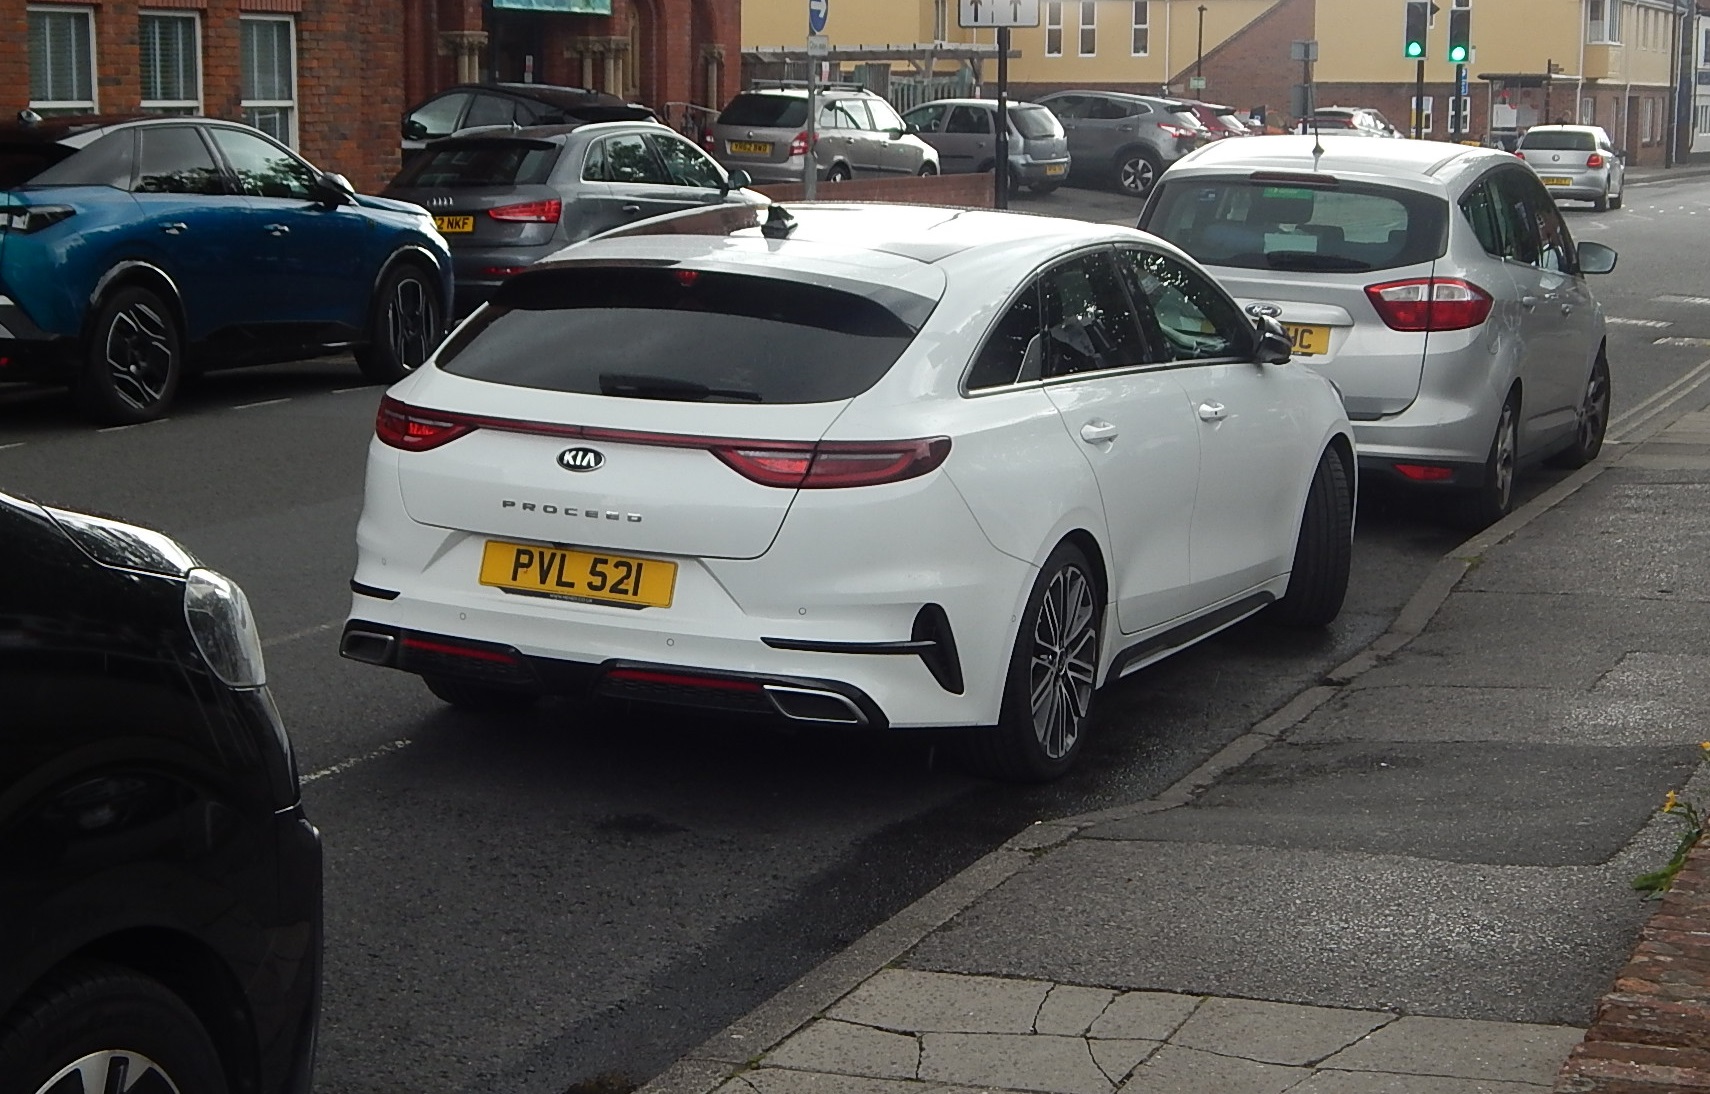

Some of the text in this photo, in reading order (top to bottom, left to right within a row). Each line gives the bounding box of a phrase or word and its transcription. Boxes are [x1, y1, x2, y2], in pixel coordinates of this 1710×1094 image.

[447, 217, 470, 230] NKF
[563, 450, 595, 467] KIA
[502, 500, 642, 522] PROCEED
[511, 548, 643, 597] PVL 521
